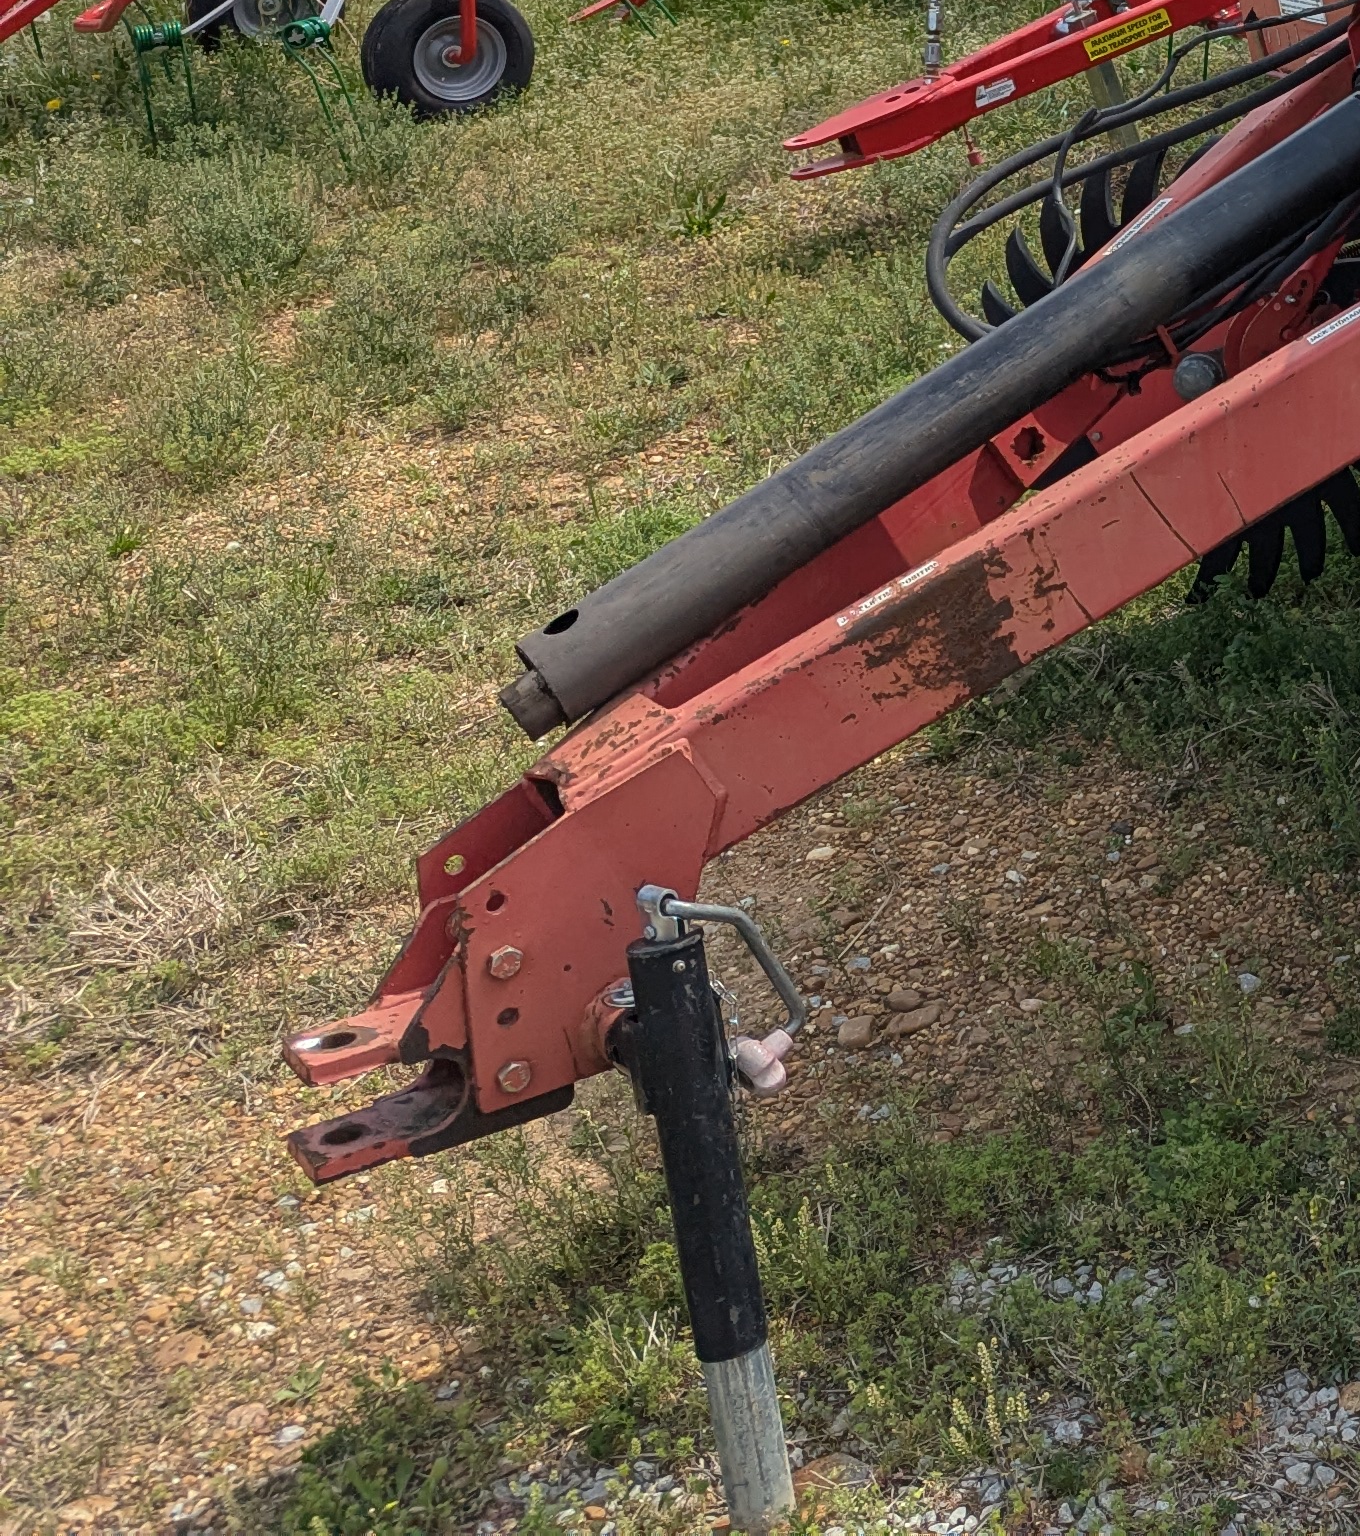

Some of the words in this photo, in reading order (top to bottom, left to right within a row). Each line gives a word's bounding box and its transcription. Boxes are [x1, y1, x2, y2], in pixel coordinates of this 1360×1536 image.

[1126, 18, 1148, 33] SPEED
[1148, 12, 1162, 24] FOR
[1108, 29, 1147, 51] TRANSPORT
[1310, 328, 1329, 343] JACK
